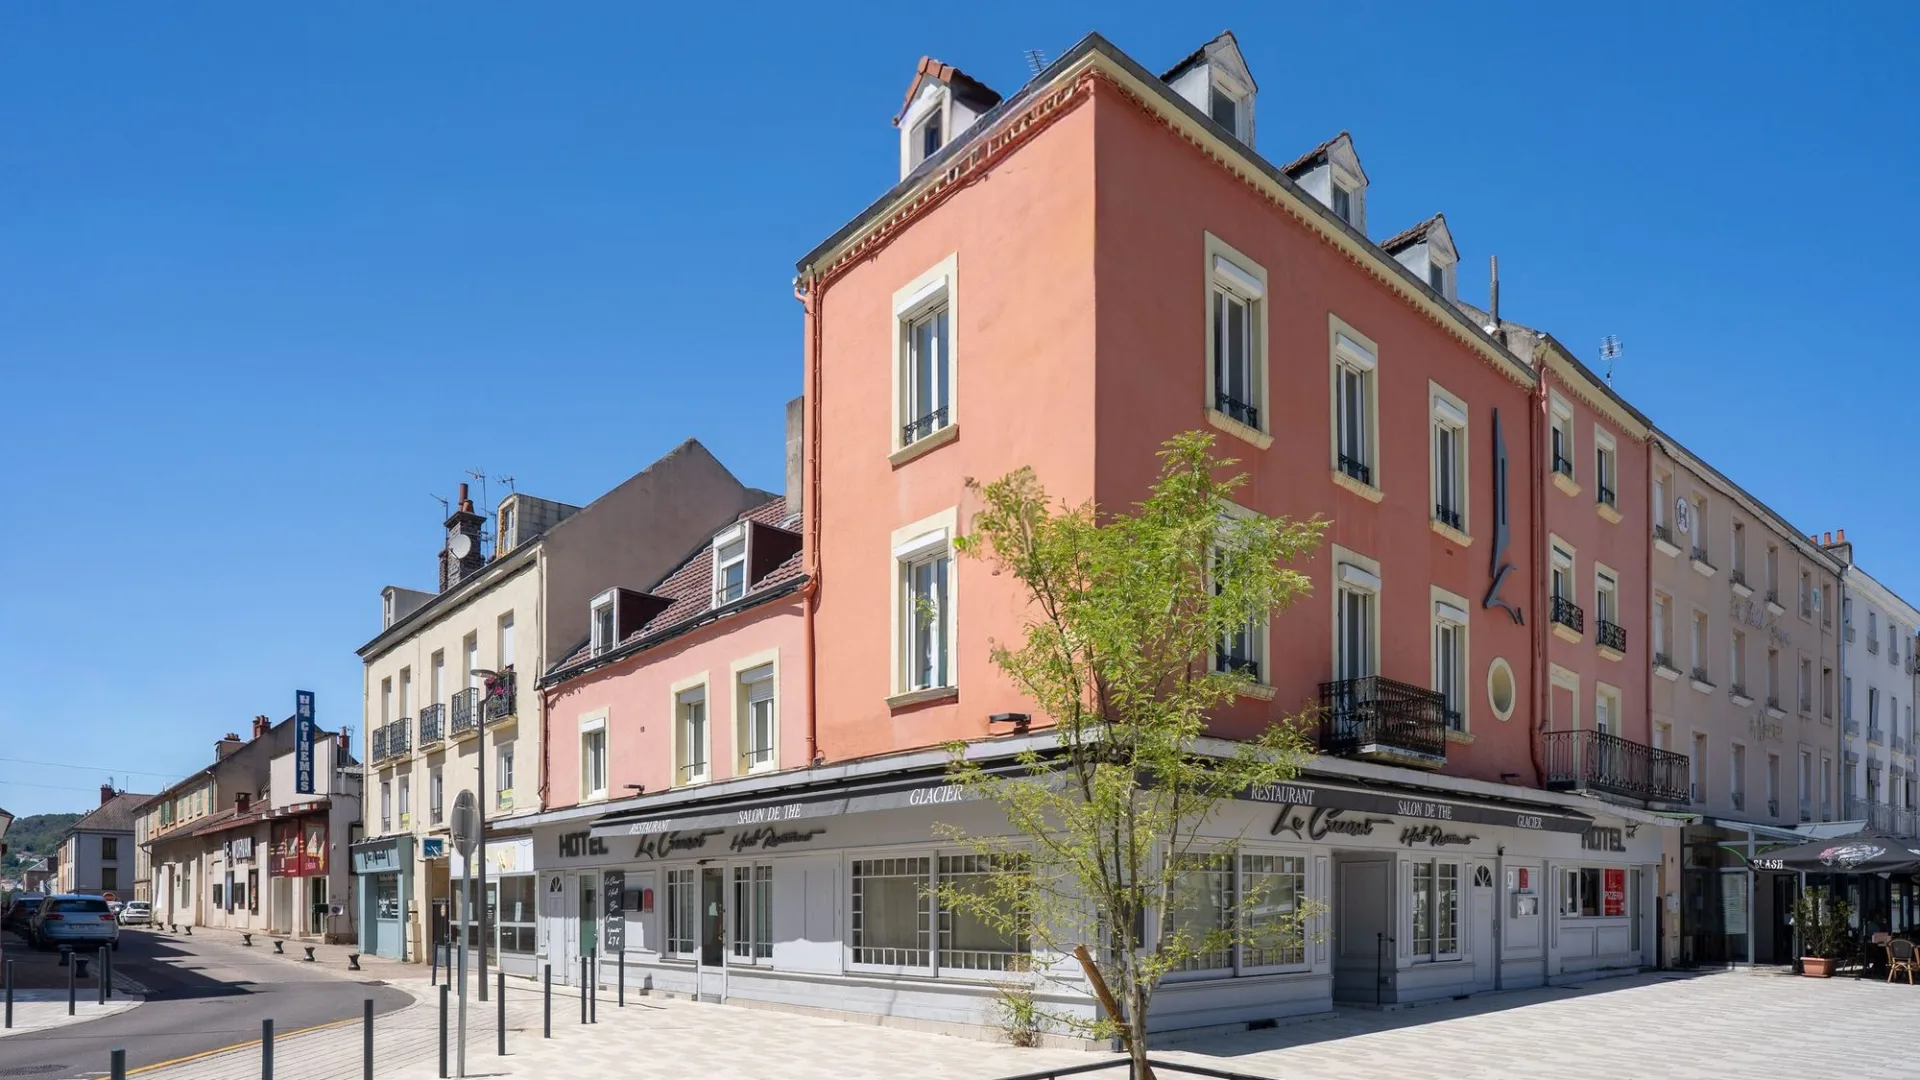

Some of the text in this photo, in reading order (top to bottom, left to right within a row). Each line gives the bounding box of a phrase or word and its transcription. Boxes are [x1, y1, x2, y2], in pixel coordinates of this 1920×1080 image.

[300, 722, 310, 791] CINEMAS
[909, 784, 963, 805] GLACIER
[1251, 784, 1315, 805] RESTAURANT
[737, 804, 802, 824] SALON DE THE
[1397, 800, 1422, 817] SALON
[1424, 804, 1436, 817] DE
[628, 820, 671, 835] RESTAURANT
[1270, 803, 1305, 840] Le
[1517, 814, 1543, 829] GLACIER
[558, 831, 609, 858] HOTEL
[1581, 826, 1626, 852] HOTEL
[1753, 855, 1783, 870] SLASH
